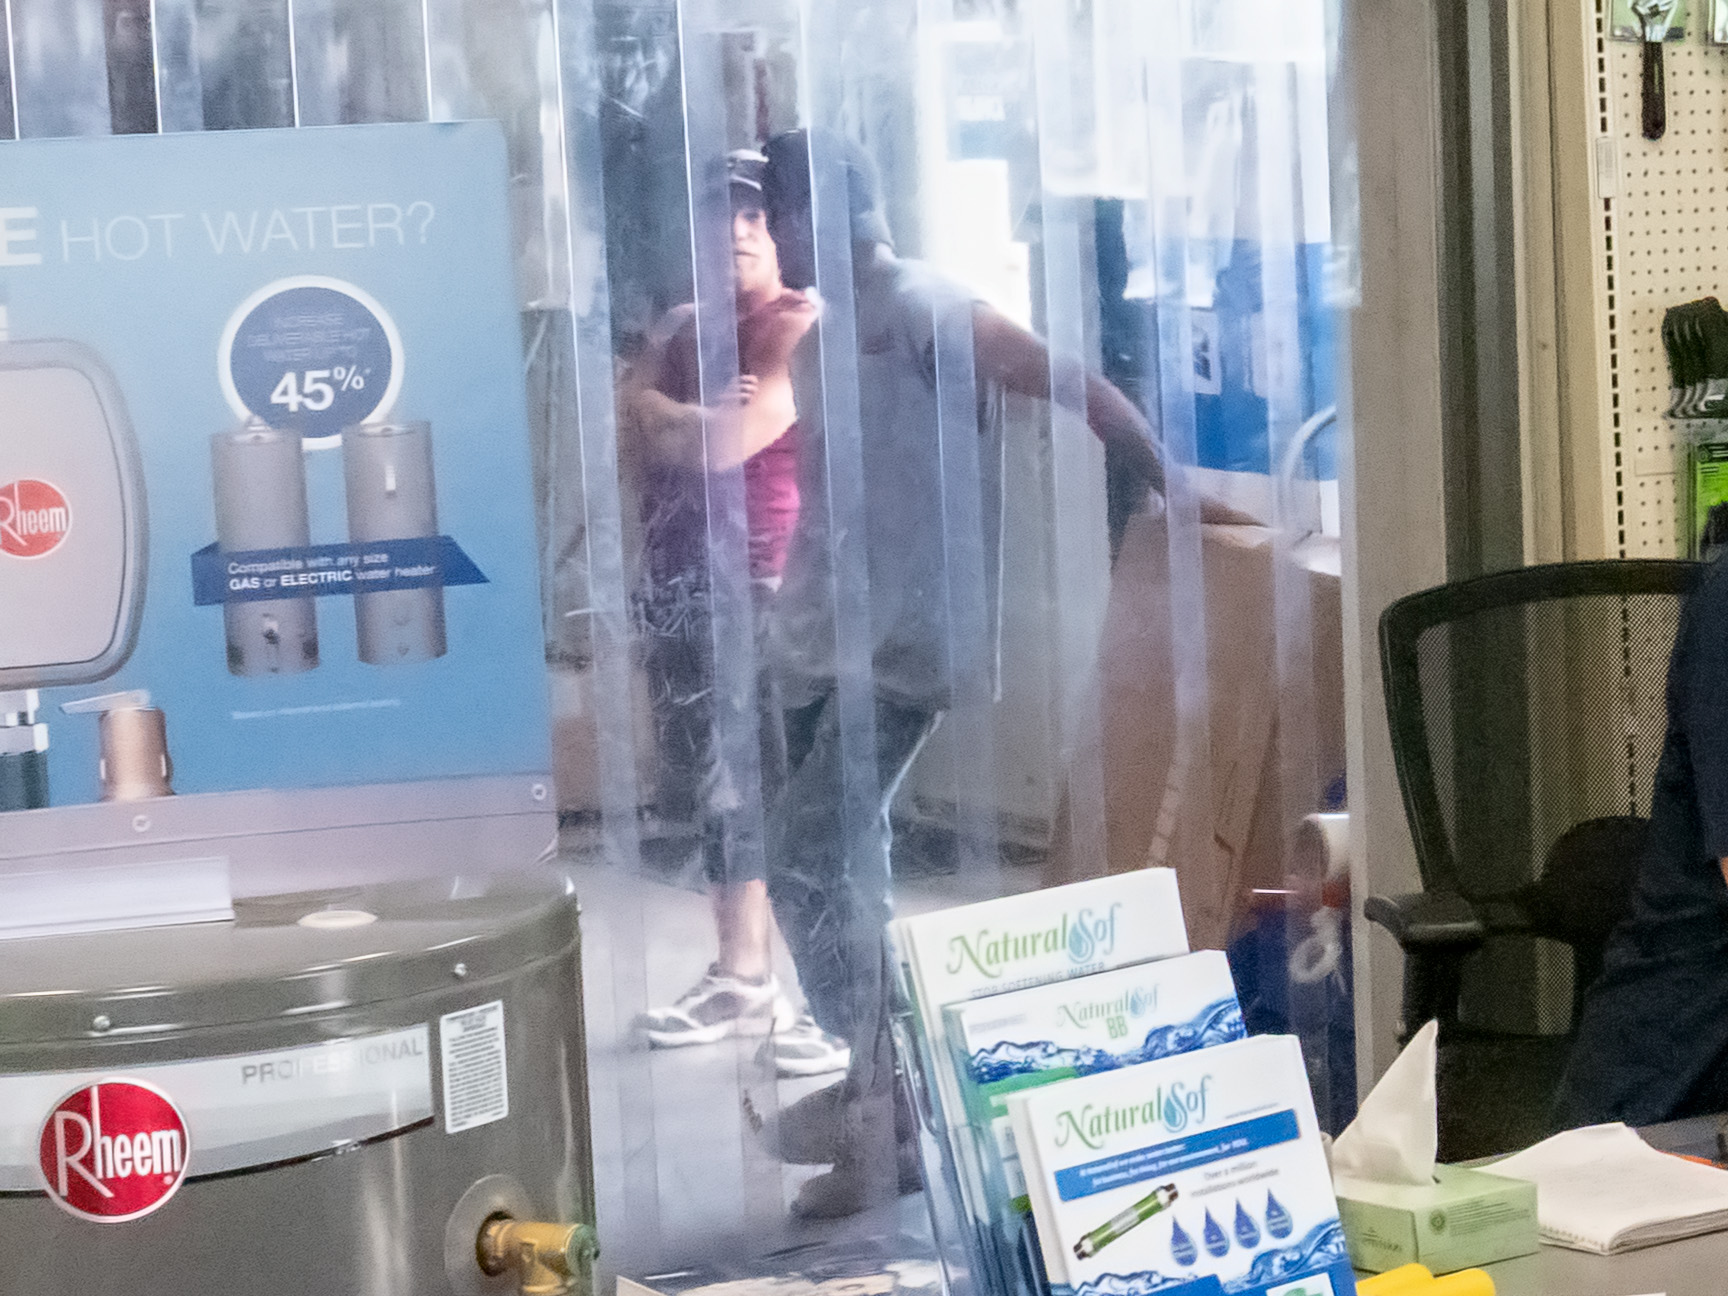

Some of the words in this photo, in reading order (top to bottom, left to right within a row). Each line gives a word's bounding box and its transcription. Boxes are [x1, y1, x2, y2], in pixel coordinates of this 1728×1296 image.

[62, 214, 184, 262] HOT
[203, 201, 437, 257] WATER?
[227, 557, 304, 575] Compatible
[306, 556, 334, 570] with
[338, 555, 360, 569] any
[363, 552, 389, 565] size
[229, 577, 261, 591] GAS
[264, 578, 278, 588] or
[280, 570, 353, 587] ELECTRIC
[355, 567, 391, 581] water
[394, 563, 437, 577] heater
[946, 902, 1123, 980] NaturalSof
[1056, 983, 1161, 1030] NaturalSof
[1106, 1015, 1129, 1039] BB
[242, 1035, 425, 1086] PROFESSIONAL
[1054, 1074, 1213, 1150] NaturalSof
[54, 1085, 182, 1198] Rheem
